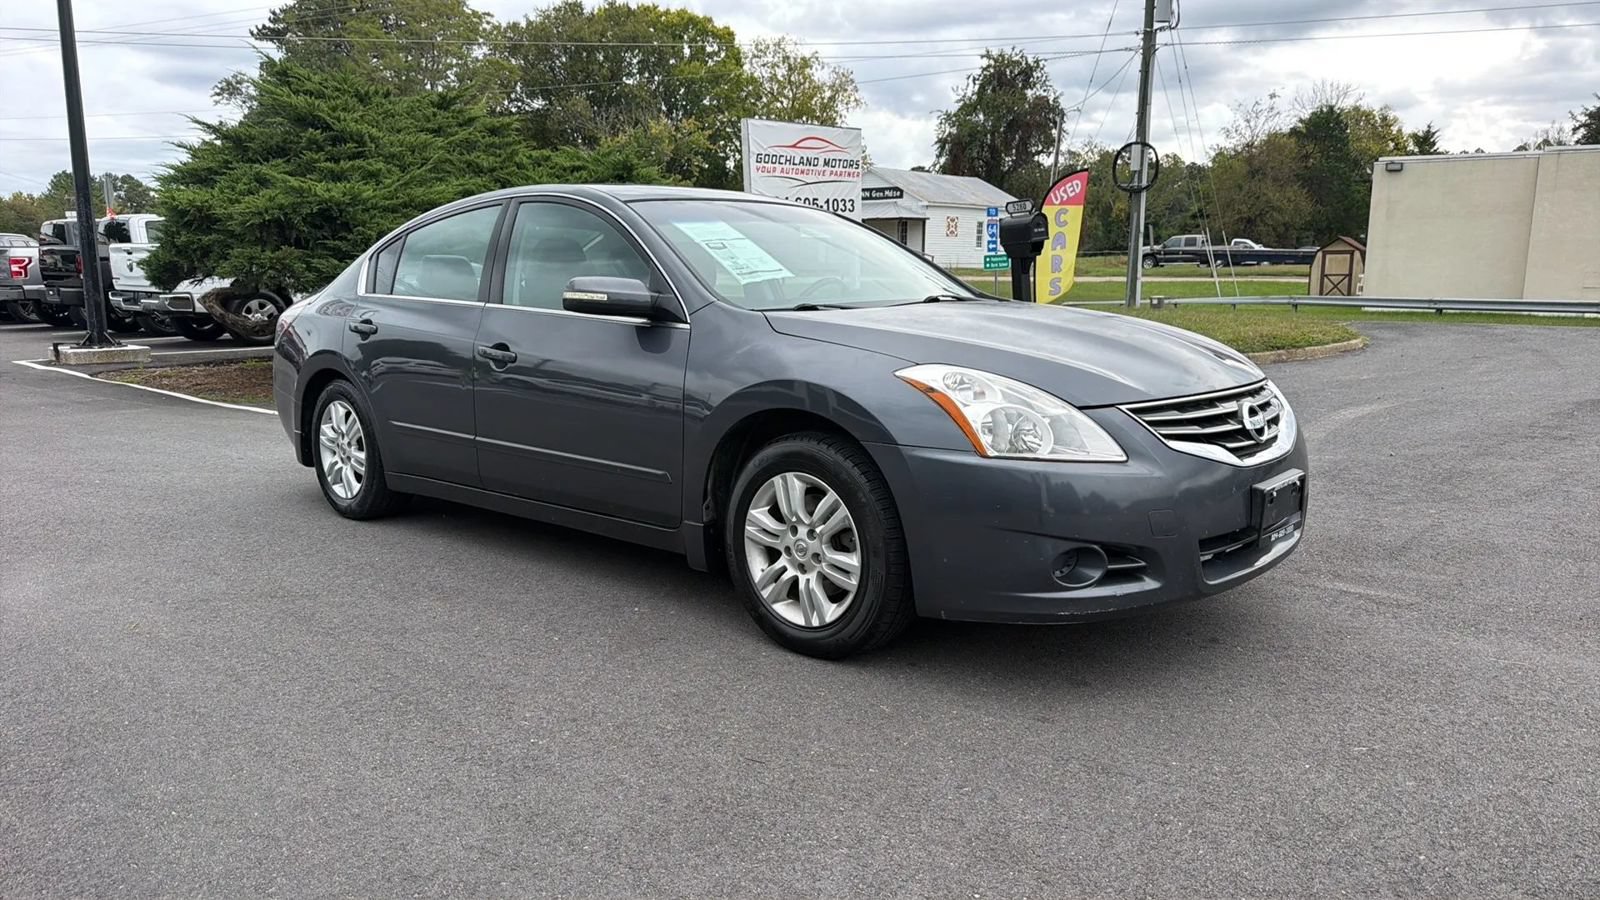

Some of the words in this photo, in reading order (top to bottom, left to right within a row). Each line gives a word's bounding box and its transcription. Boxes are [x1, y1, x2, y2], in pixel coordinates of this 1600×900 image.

[755, 153, 819, 167] GOOCHLAND
[823, 158, 860, 169] MOTORS
[755, 165, 777, 174] YOUR
[780, 167, 825, 177] AUTOMOTIVE
[829, 170, 860, 178] PARTNER
[1051, 179, 1081, 204] USED
[1048, 208, 1069, 296] CARS
